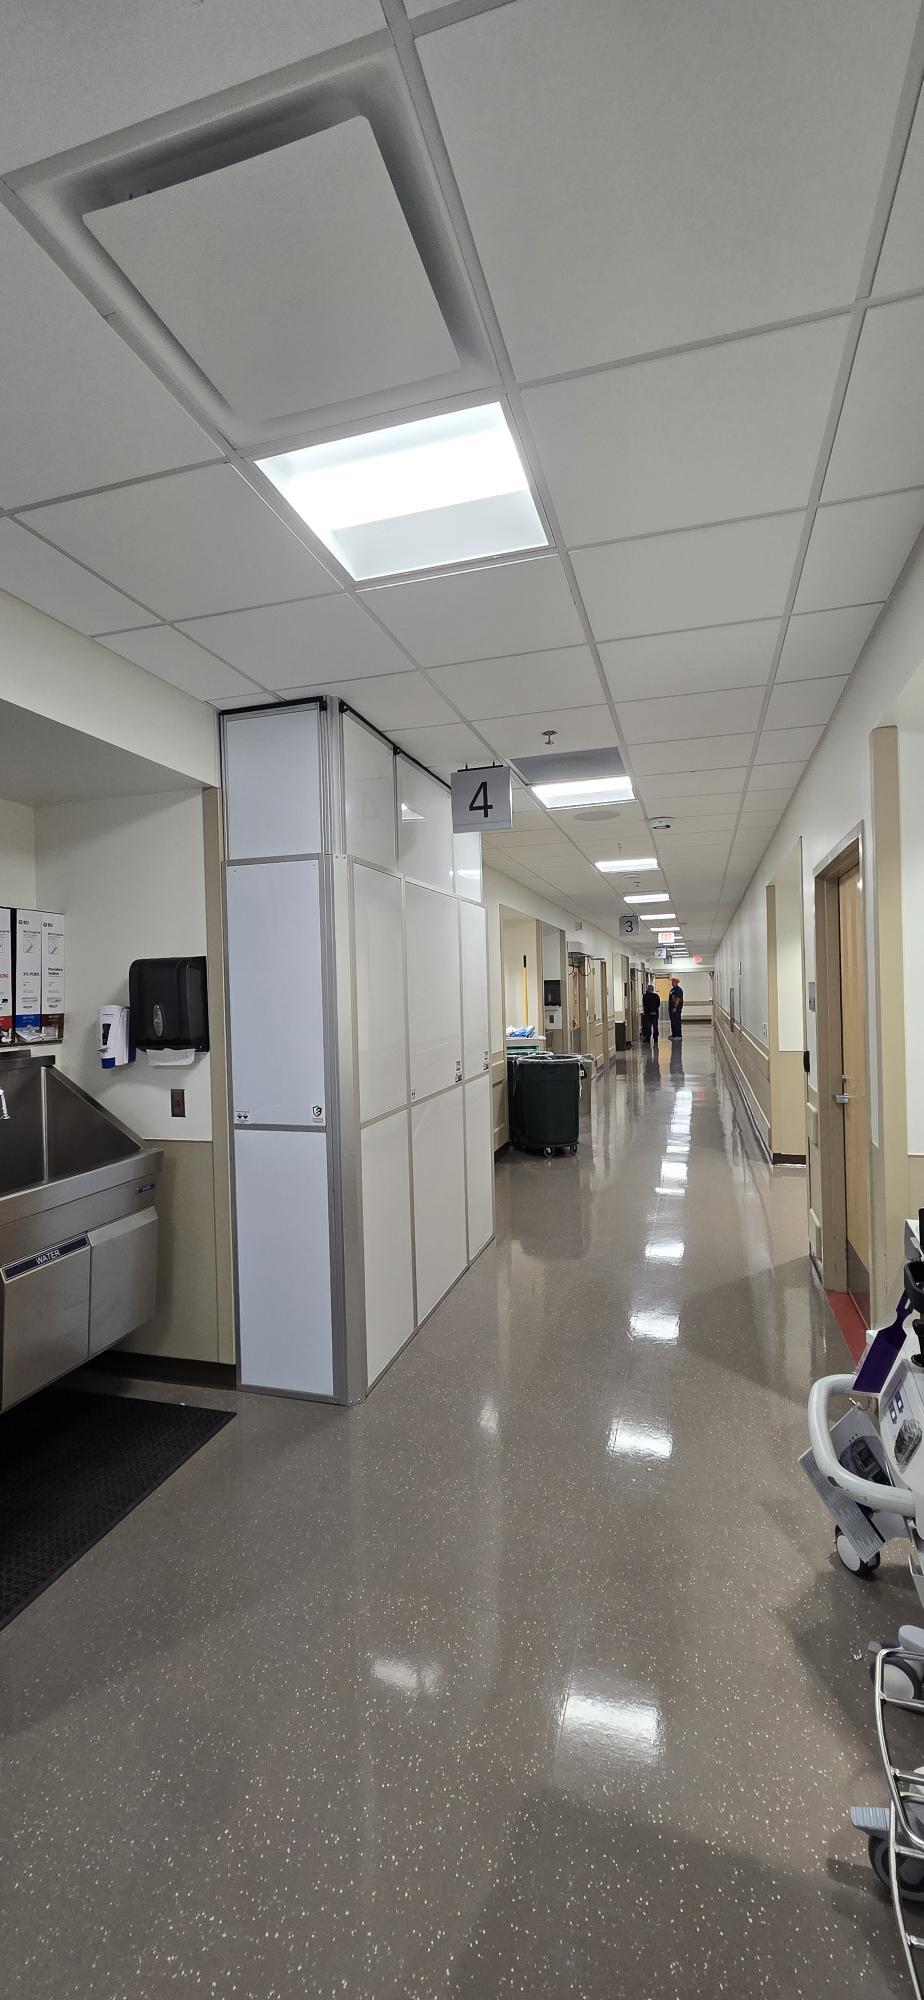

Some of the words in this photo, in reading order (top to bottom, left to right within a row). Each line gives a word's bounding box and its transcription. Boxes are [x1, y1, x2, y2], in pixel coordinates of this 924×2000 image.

[469, 781, 493, 818] 4
[625, 920, 634, 933] 3
[35, 1249, 61, 1265] WATER
